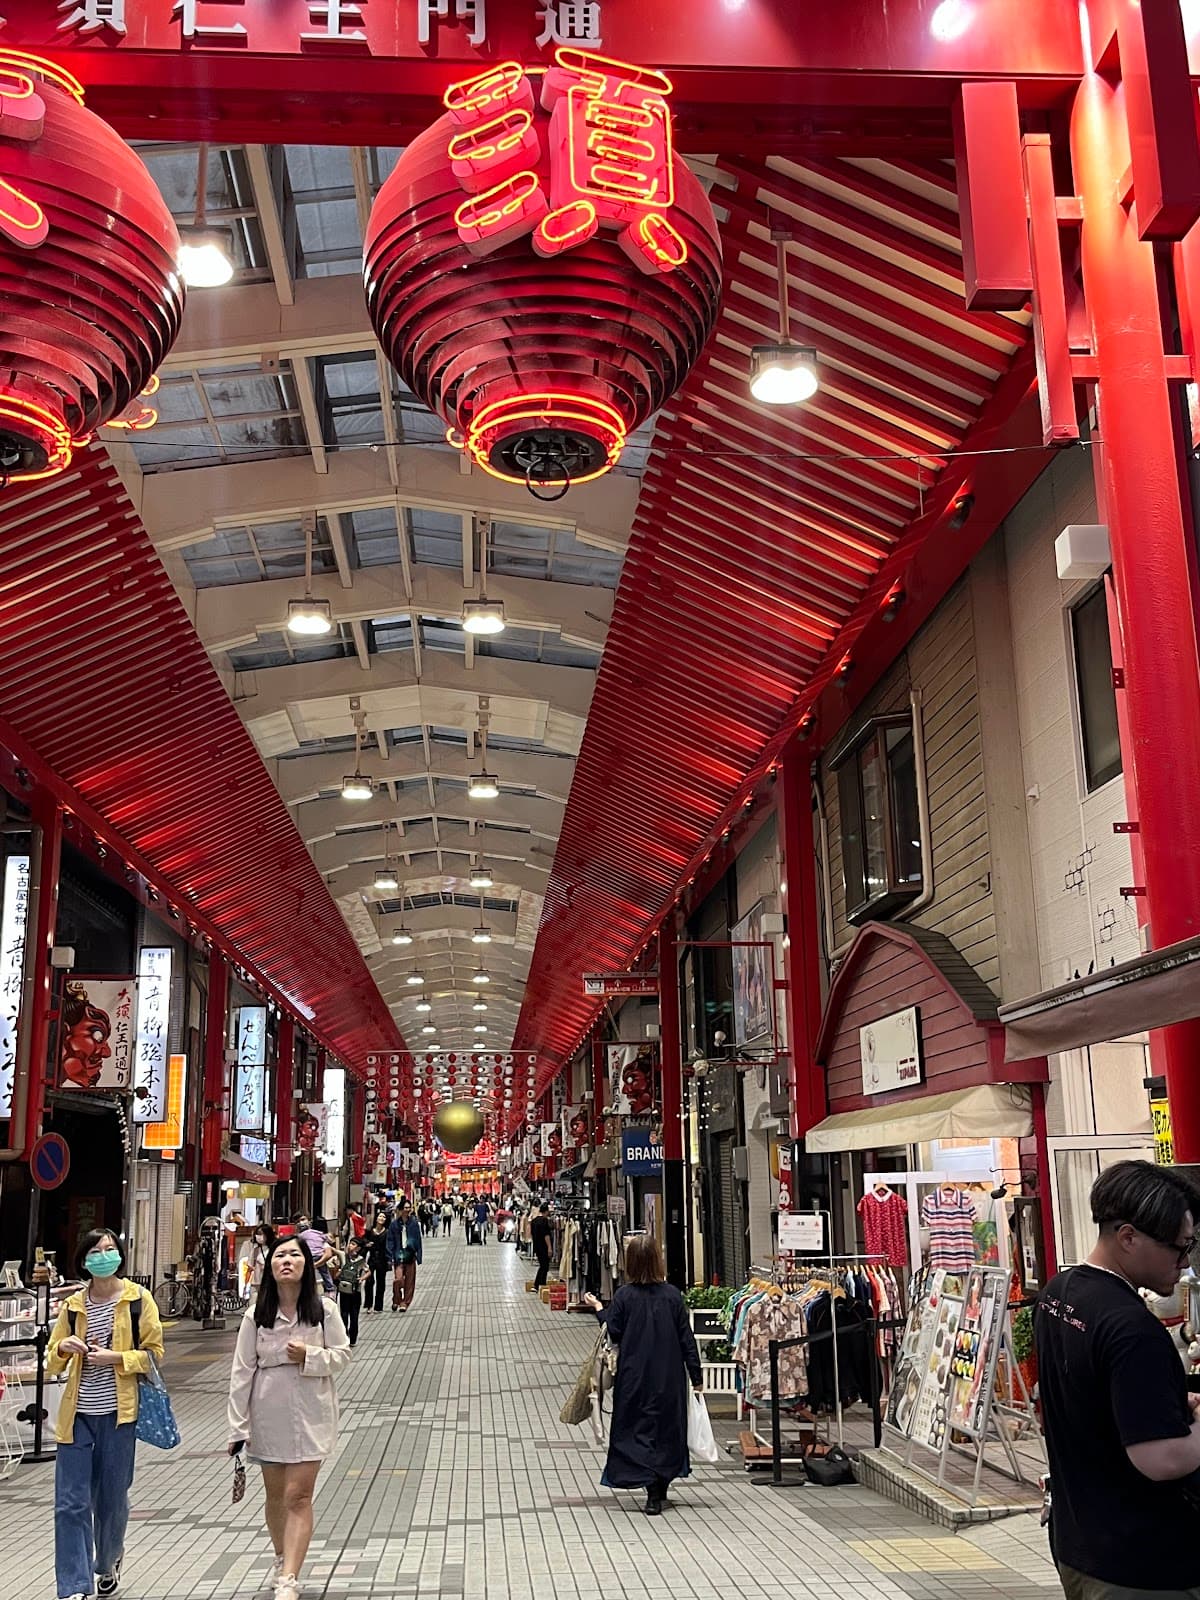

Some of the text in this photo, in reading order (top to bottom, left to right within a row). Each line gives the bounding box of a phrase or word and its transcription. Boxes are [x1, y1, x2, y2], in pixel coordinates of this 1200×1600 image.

[0, 0, 602, 49] 須仁王門通
[443, 47, 688, 275] 須
[114, 988, 132, 1084] 大須仁王門通り
